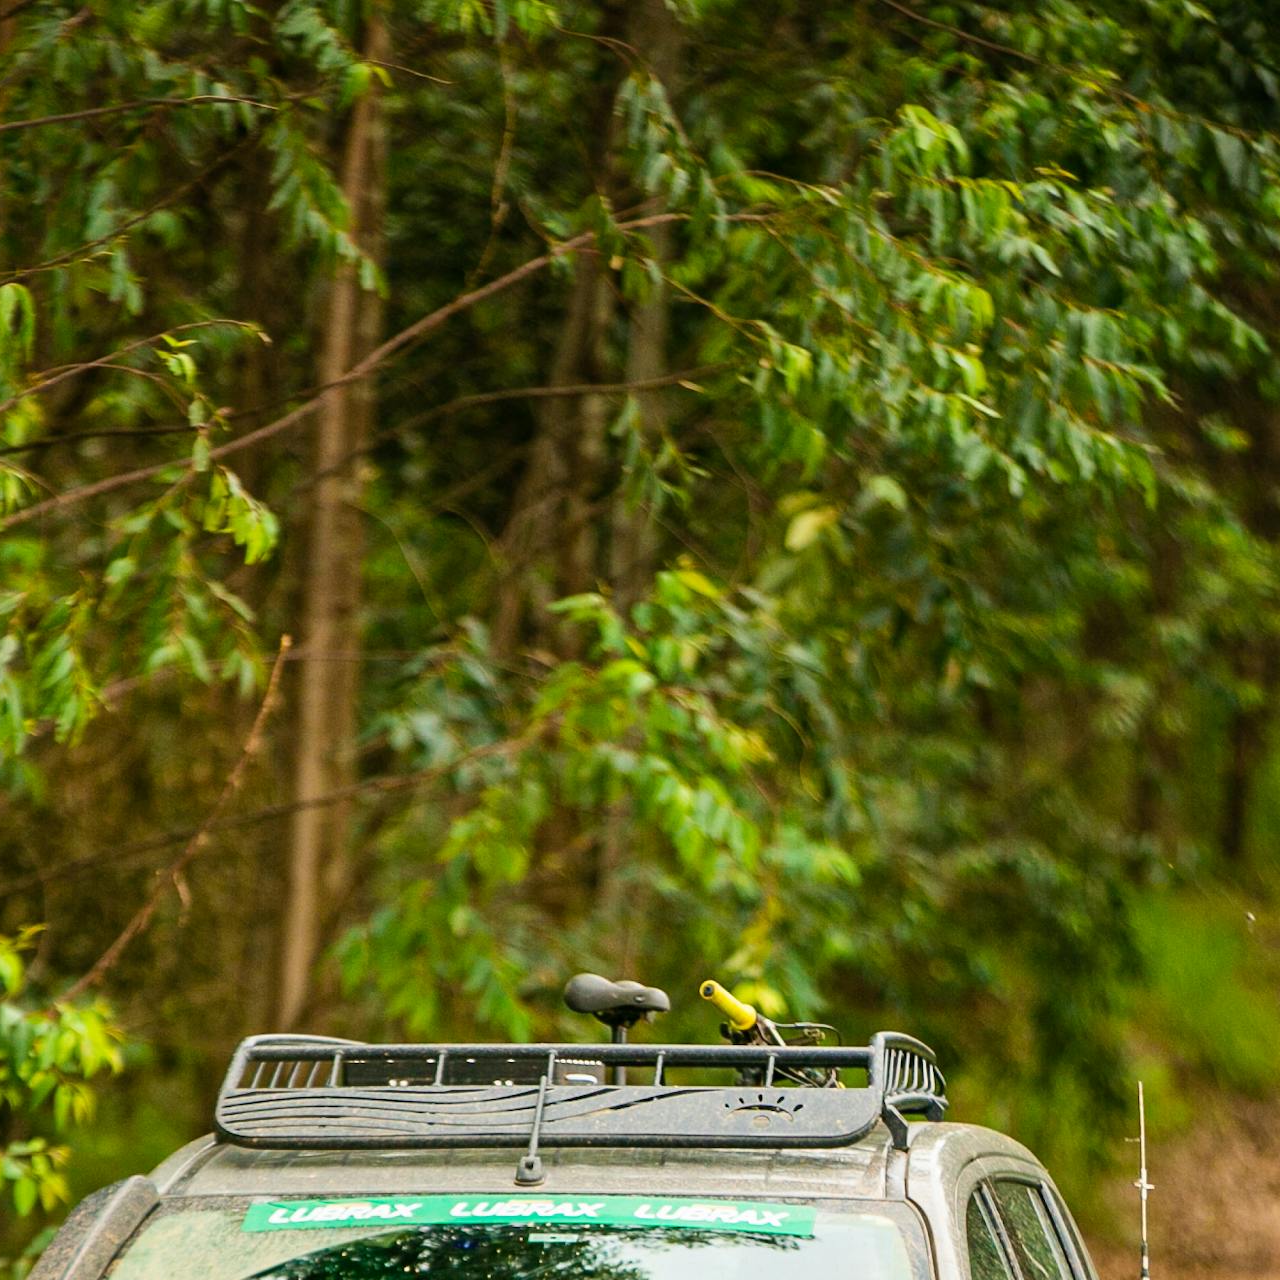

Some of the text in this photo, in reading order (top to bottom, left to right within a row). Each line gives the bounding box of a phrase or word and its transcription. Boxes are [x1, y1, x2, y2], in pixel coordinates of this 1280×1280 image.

[269, 1201, 789, 1227] LUBRAX LUBRAX LUBRAX
